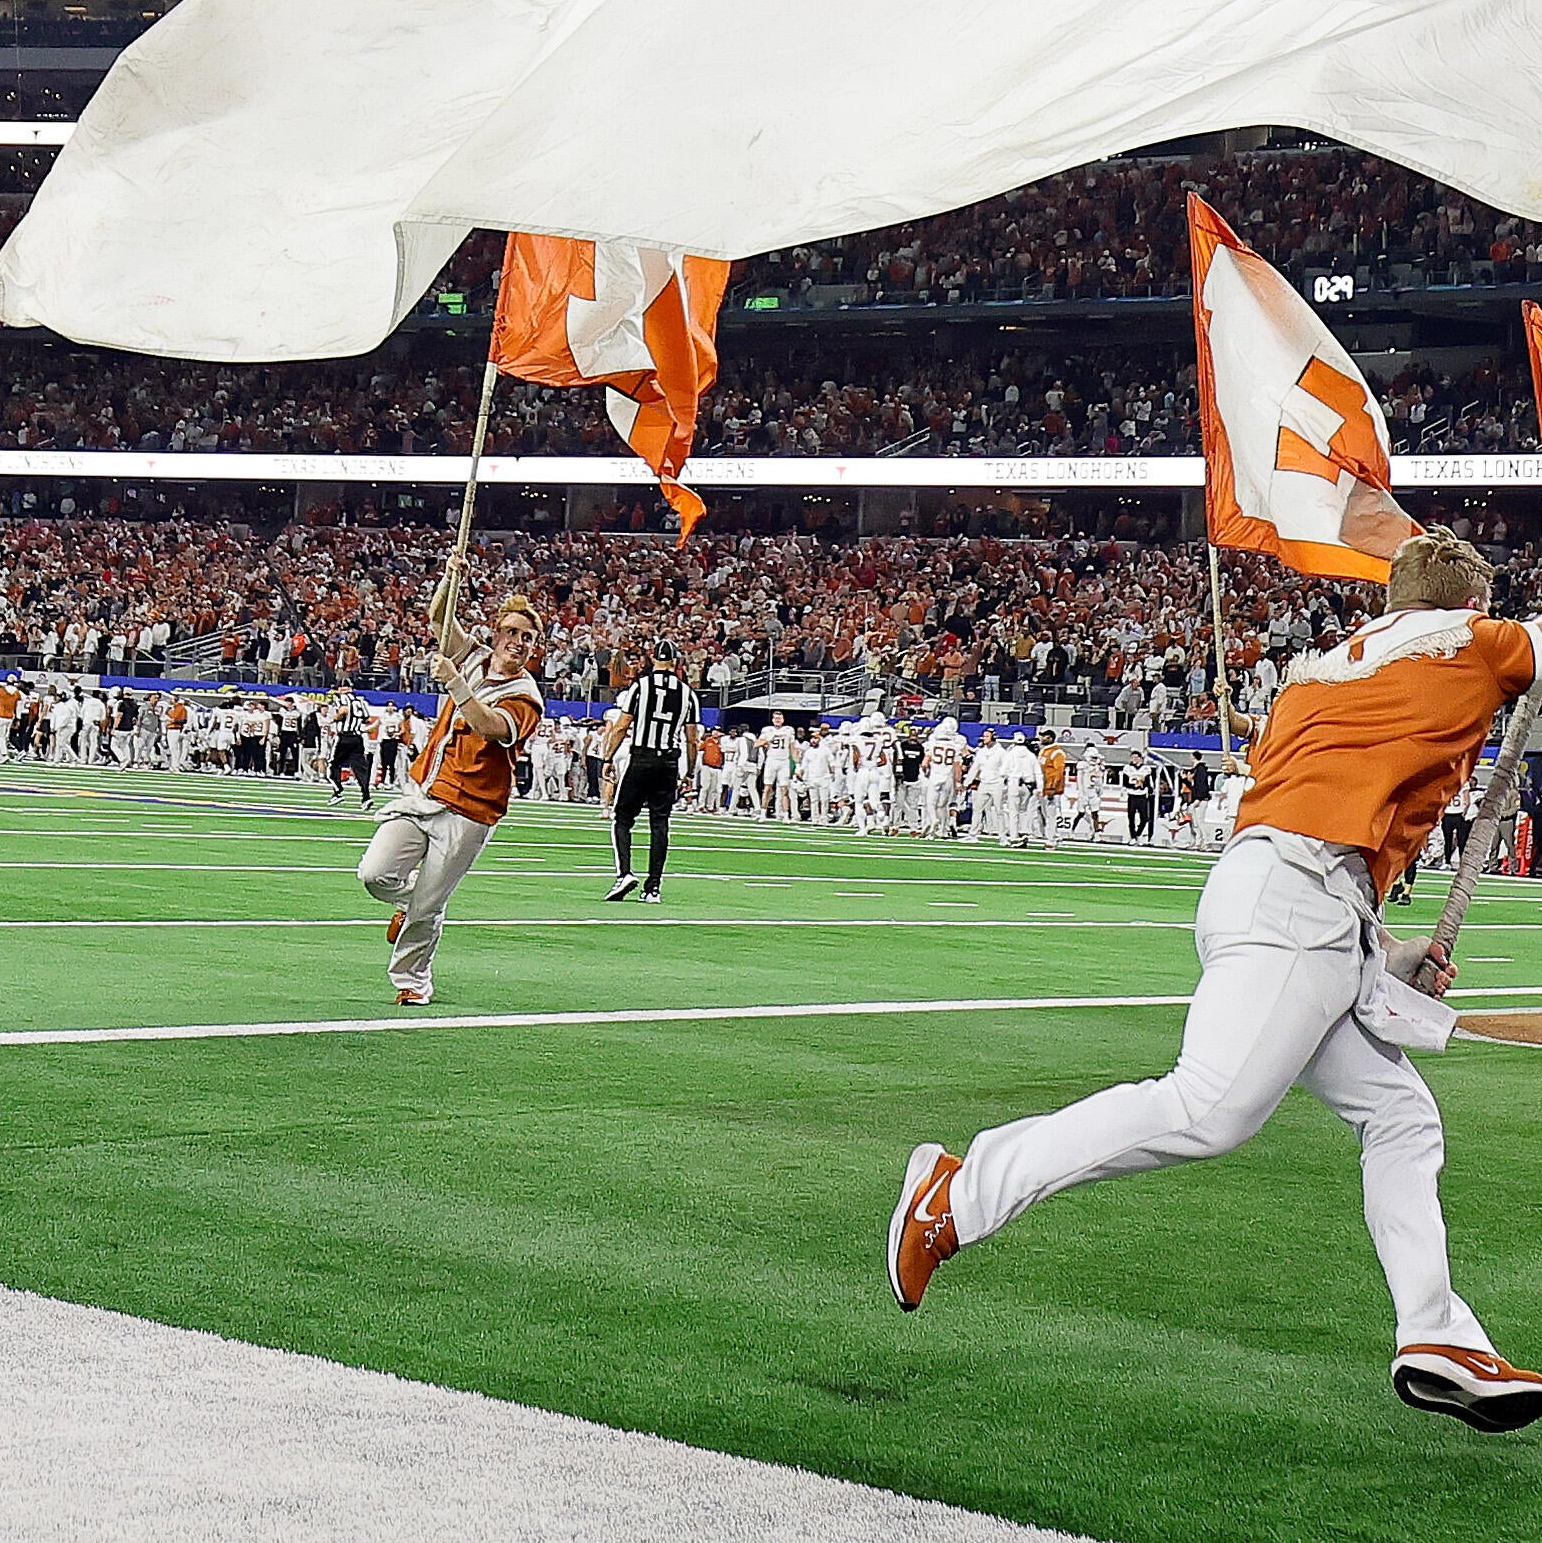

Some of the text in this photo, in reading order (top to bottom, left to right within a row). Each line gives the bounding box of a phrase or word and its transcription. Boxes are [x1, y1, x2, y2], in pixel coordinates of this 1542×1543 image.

[984, 462, 1148, 480] TEXAS LONGHORNS
[1410, 460, 1475, 478] TEXAS
[653, 688, 673, 721] L
[932, 746, 956, 766] 58
[1056, 815, 1072, 829] 25
